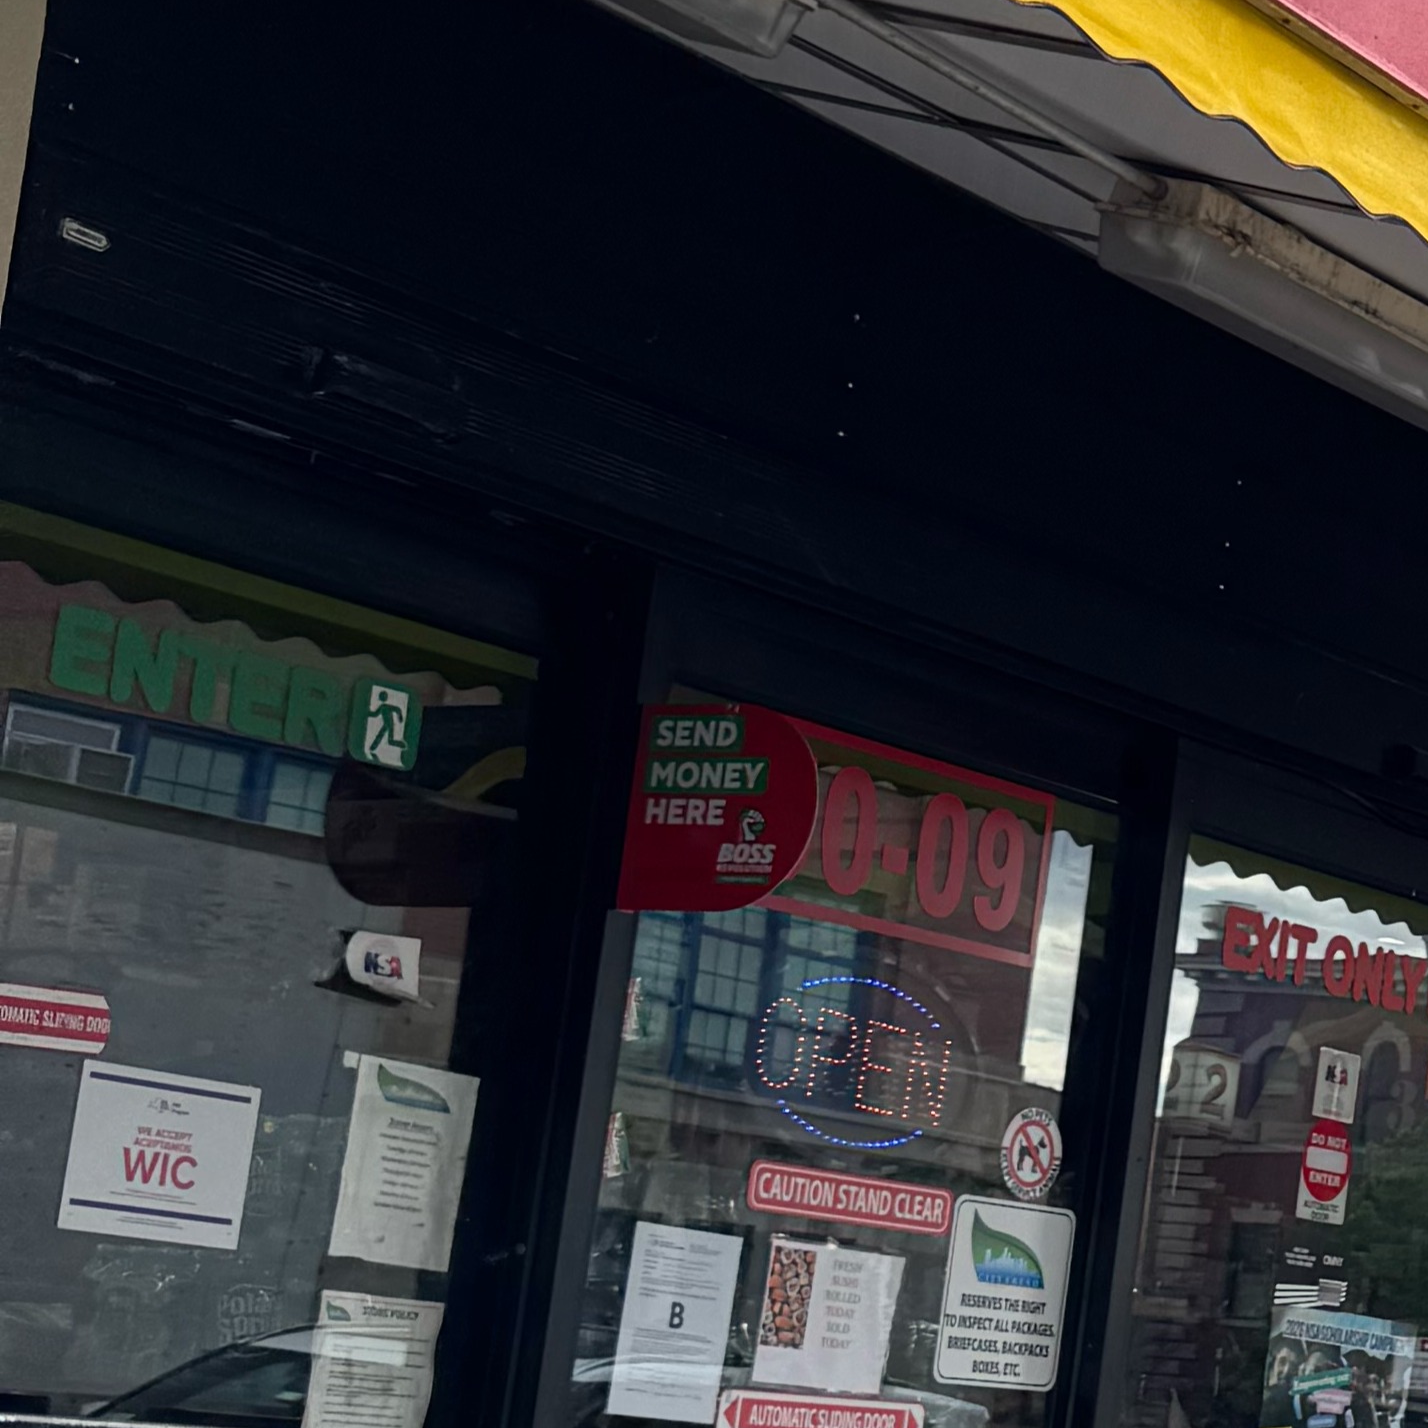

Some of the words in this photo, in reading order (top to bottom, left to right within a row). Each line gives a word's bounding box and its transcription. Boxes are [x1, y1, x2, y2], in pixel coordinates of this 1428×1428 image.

[50, 603, 346, 757] ENTER
[657, 720, 738, 748] SEND
[650, 764, 766, 790] MONEY
[645, 799, 726, 825] HERE
[717, 843, 776, 864] BOSS
[1221, 905, 1318, 986] EXIT
[1323, 933, 1428, 1015] ONLY
[0, 1005, 40, 1026] OMATIC
[756, 997, 952, 1127] OPEN
[1312, 1133, 1325, 1145] DO
[123, 1147, 198, 1190] WIC
[759, 1173, 834, 1206] CAUTION
[836, 1185, 891, 1216] STAND
[894, 1193, 944, 1225] CLEAR
[825, 1290, 861, 1304] ROLLED
[961, 1293, 1002, 1311] RESERVES
[1004, 1298, 1020, 1312] THE
[1021, 1300, 1046, 1315] RIGHT
[668, 1302, 685, 1328] B
[944, 1313, 957, 1327] TO
[958, 1316, 993, 1331] INSPECT
[994, 1320, 1010, 1333] ALL
[1002, 1341, 1049, 1358] BACKPACKS
